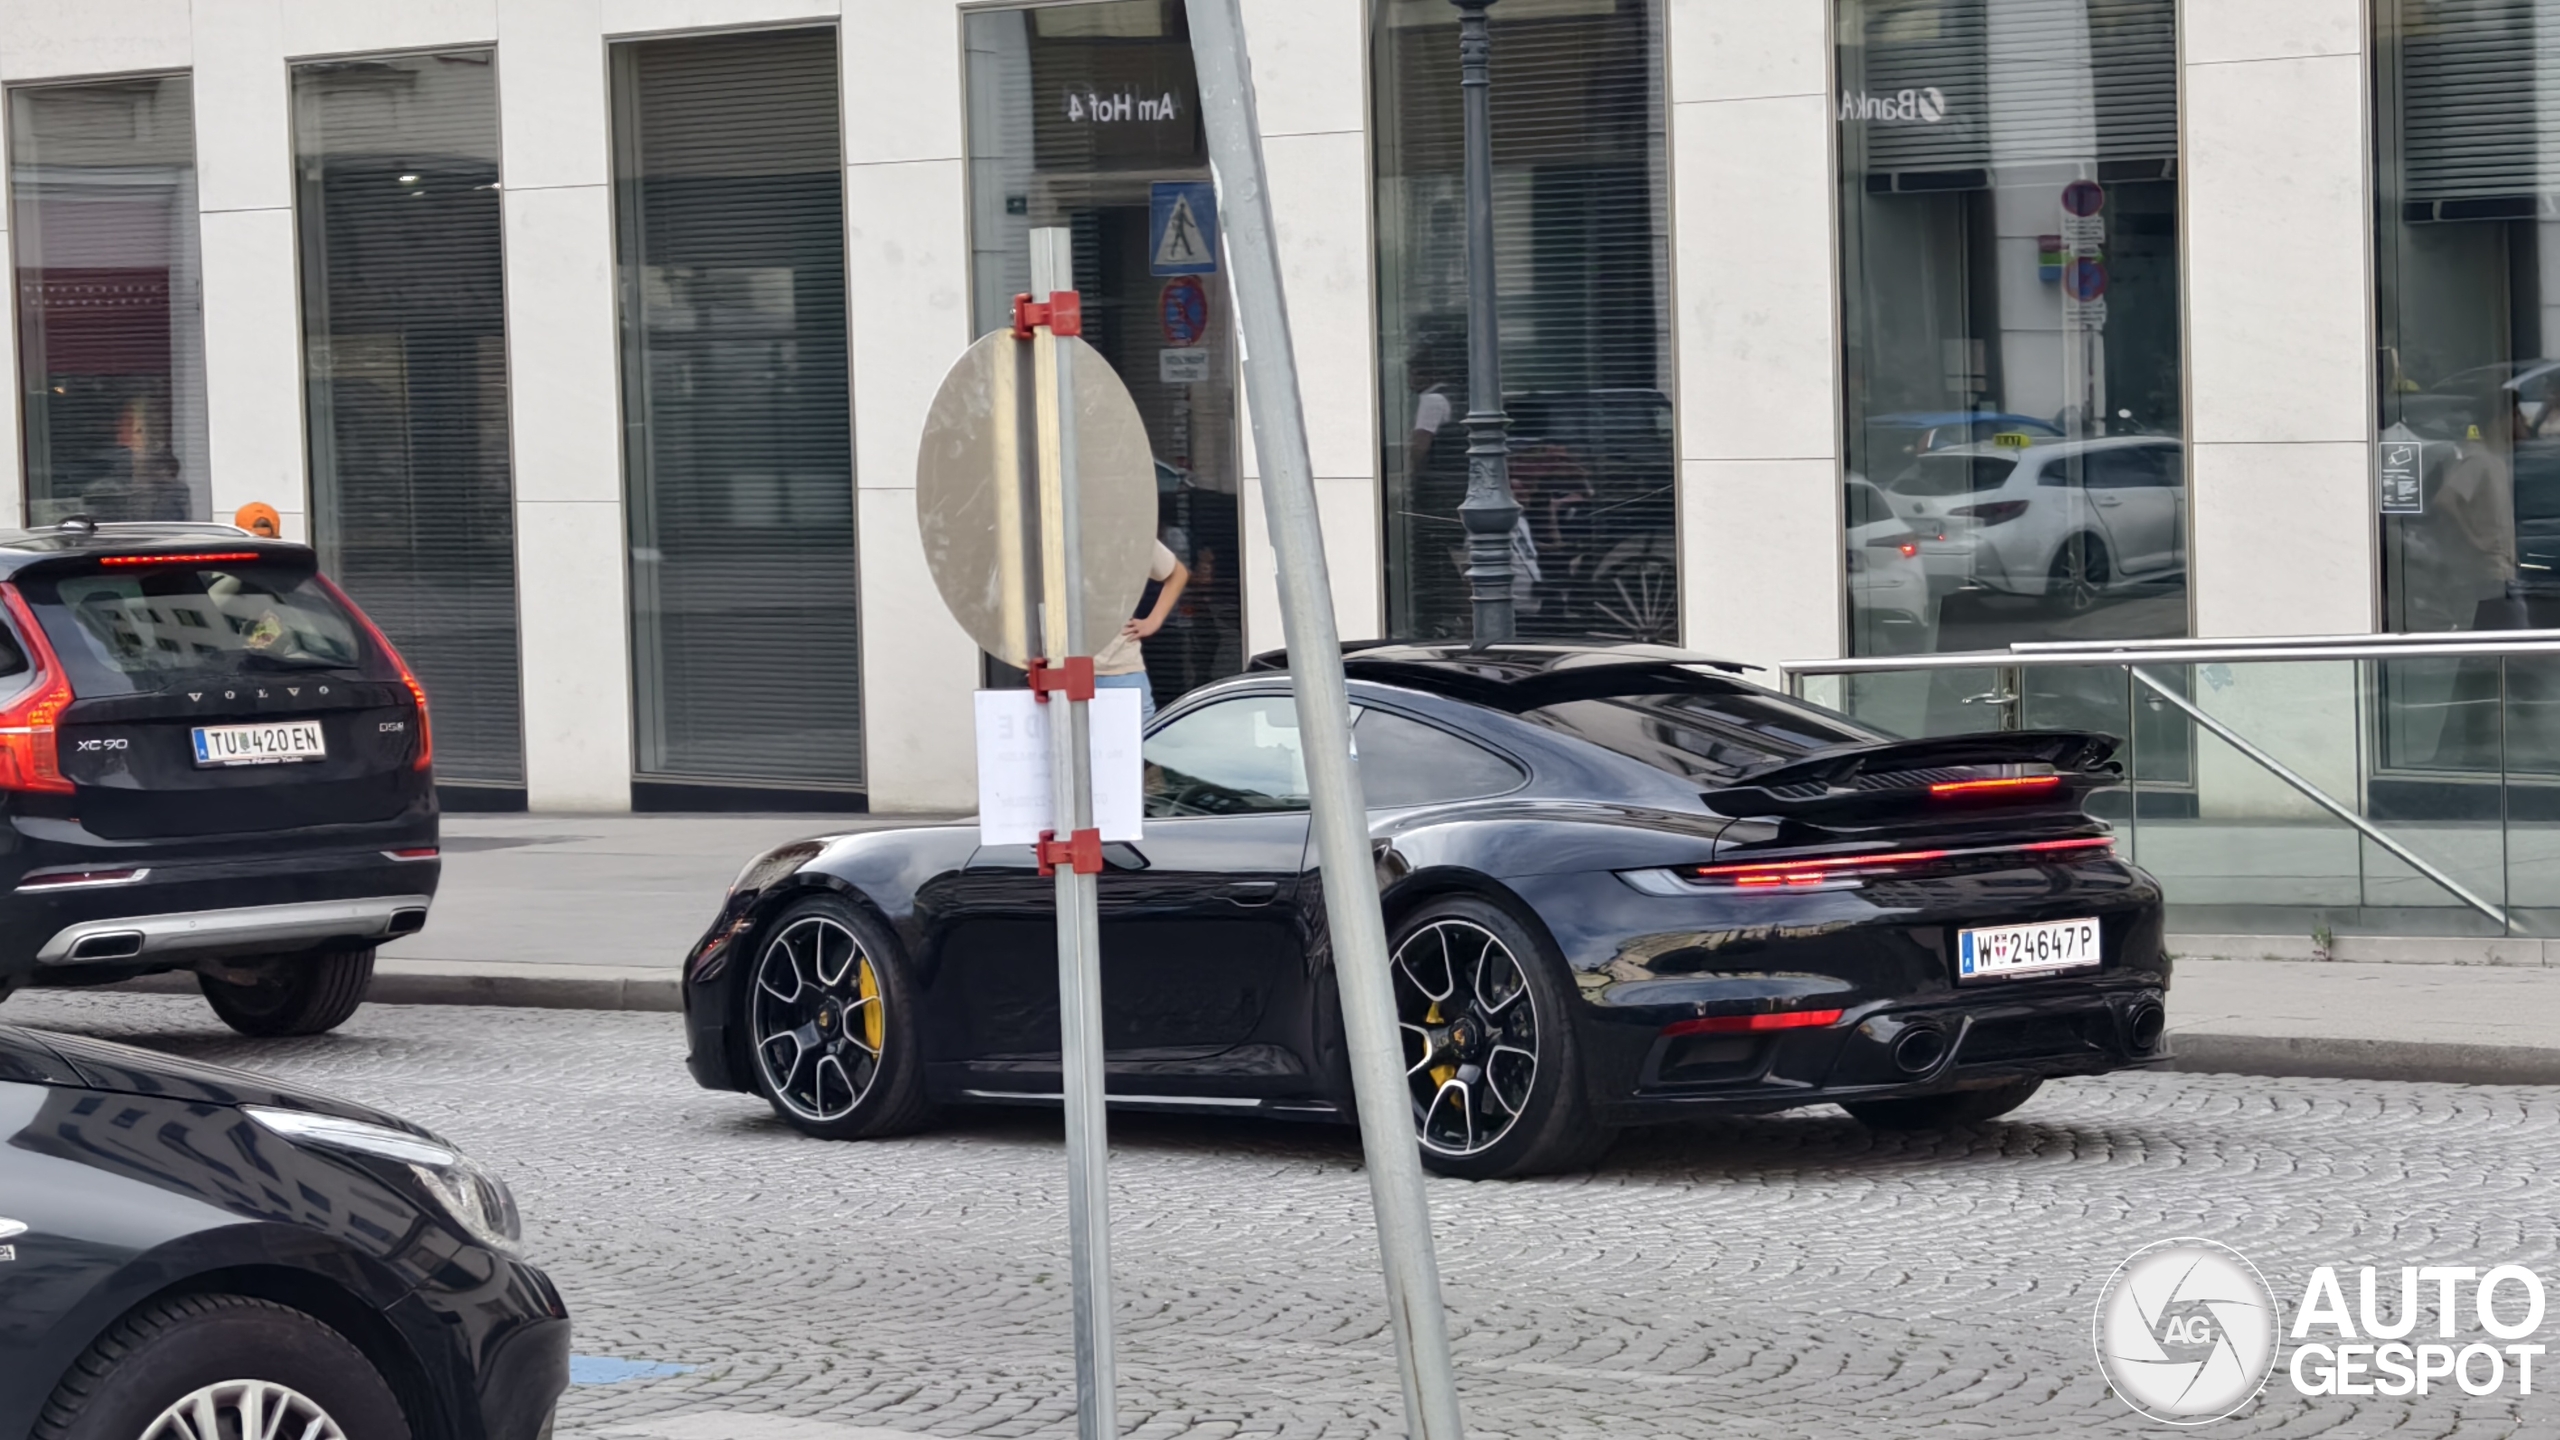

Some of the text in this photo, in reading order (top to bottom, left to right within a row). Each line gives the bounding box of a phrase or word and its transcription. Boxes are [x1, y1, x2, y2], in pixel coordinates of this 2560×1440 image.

[188, 685, 330, 702] VOLVO
[211, 727, 318, 756] TU 420 EN
[1978, 926, 2092, 967] W 24647 P
